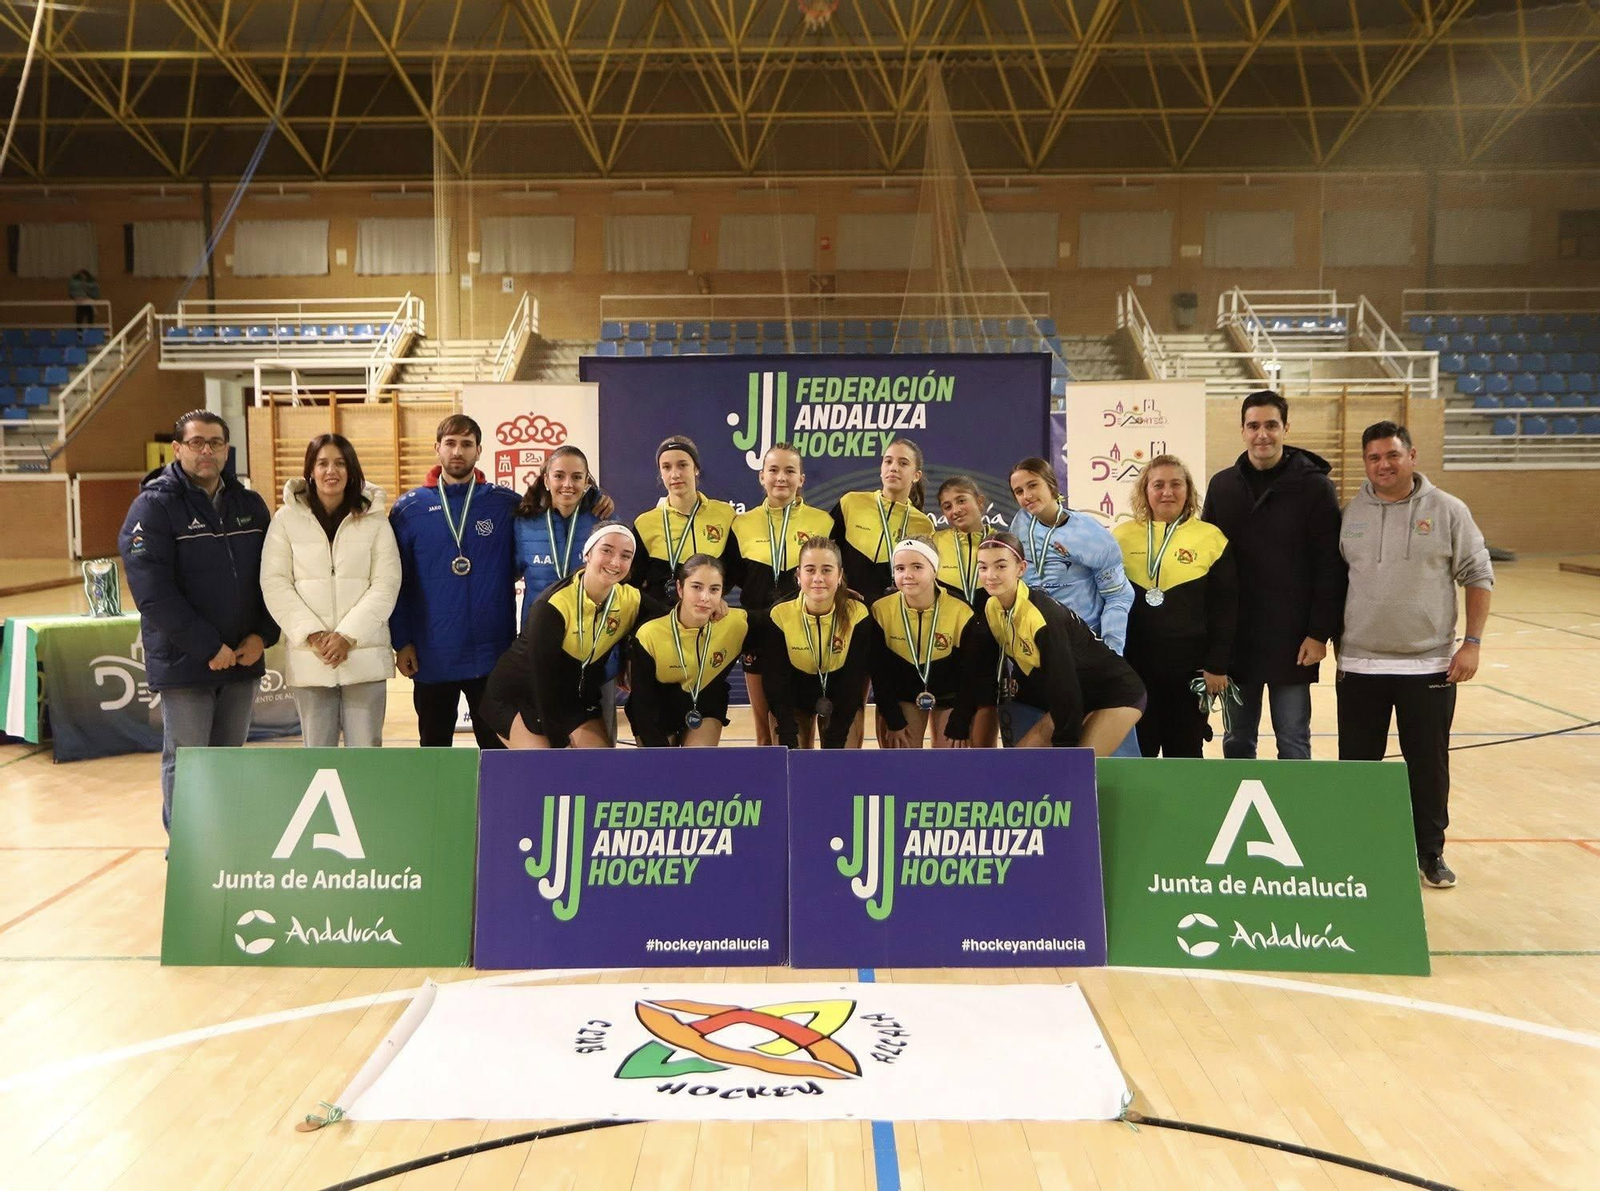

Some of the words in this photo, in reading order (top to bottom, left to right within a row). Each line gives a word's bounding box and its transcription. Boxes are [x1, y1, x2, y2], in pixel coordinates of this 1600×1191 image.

[796, 369, 955, 402] FEDERACIÓN
[794, 403, 926, 430] ANDALUZA
[793, 431, 896, 458] HOCKEY
[593, 793, 762, 828] FEDERACIÓN
[904, 794, 1072, 828] FEDERACIÓN
[591, 828, 733, 857] ANDALUZA
[903, 829, 1045, 857] ANDALUZA
[212, 869, 275, 890] Junta
[281, 869, 308, 890] de
[312, 866, 422, 890] Andalucía
[588, 858, 700, 886] HOCKEY
[900, 858, 1012, 885] HOCKEY
[1148, 873, 1213, 895] Junta
[1219, 875, 1247, 896] de
[1252, 875, 1368, 898] Andalucía
[285, 916, 402, 945] Andalucía
[1228, 920, 1356, 952] Andalucía
[656, 1081, 824, 1099] HOCKEY
